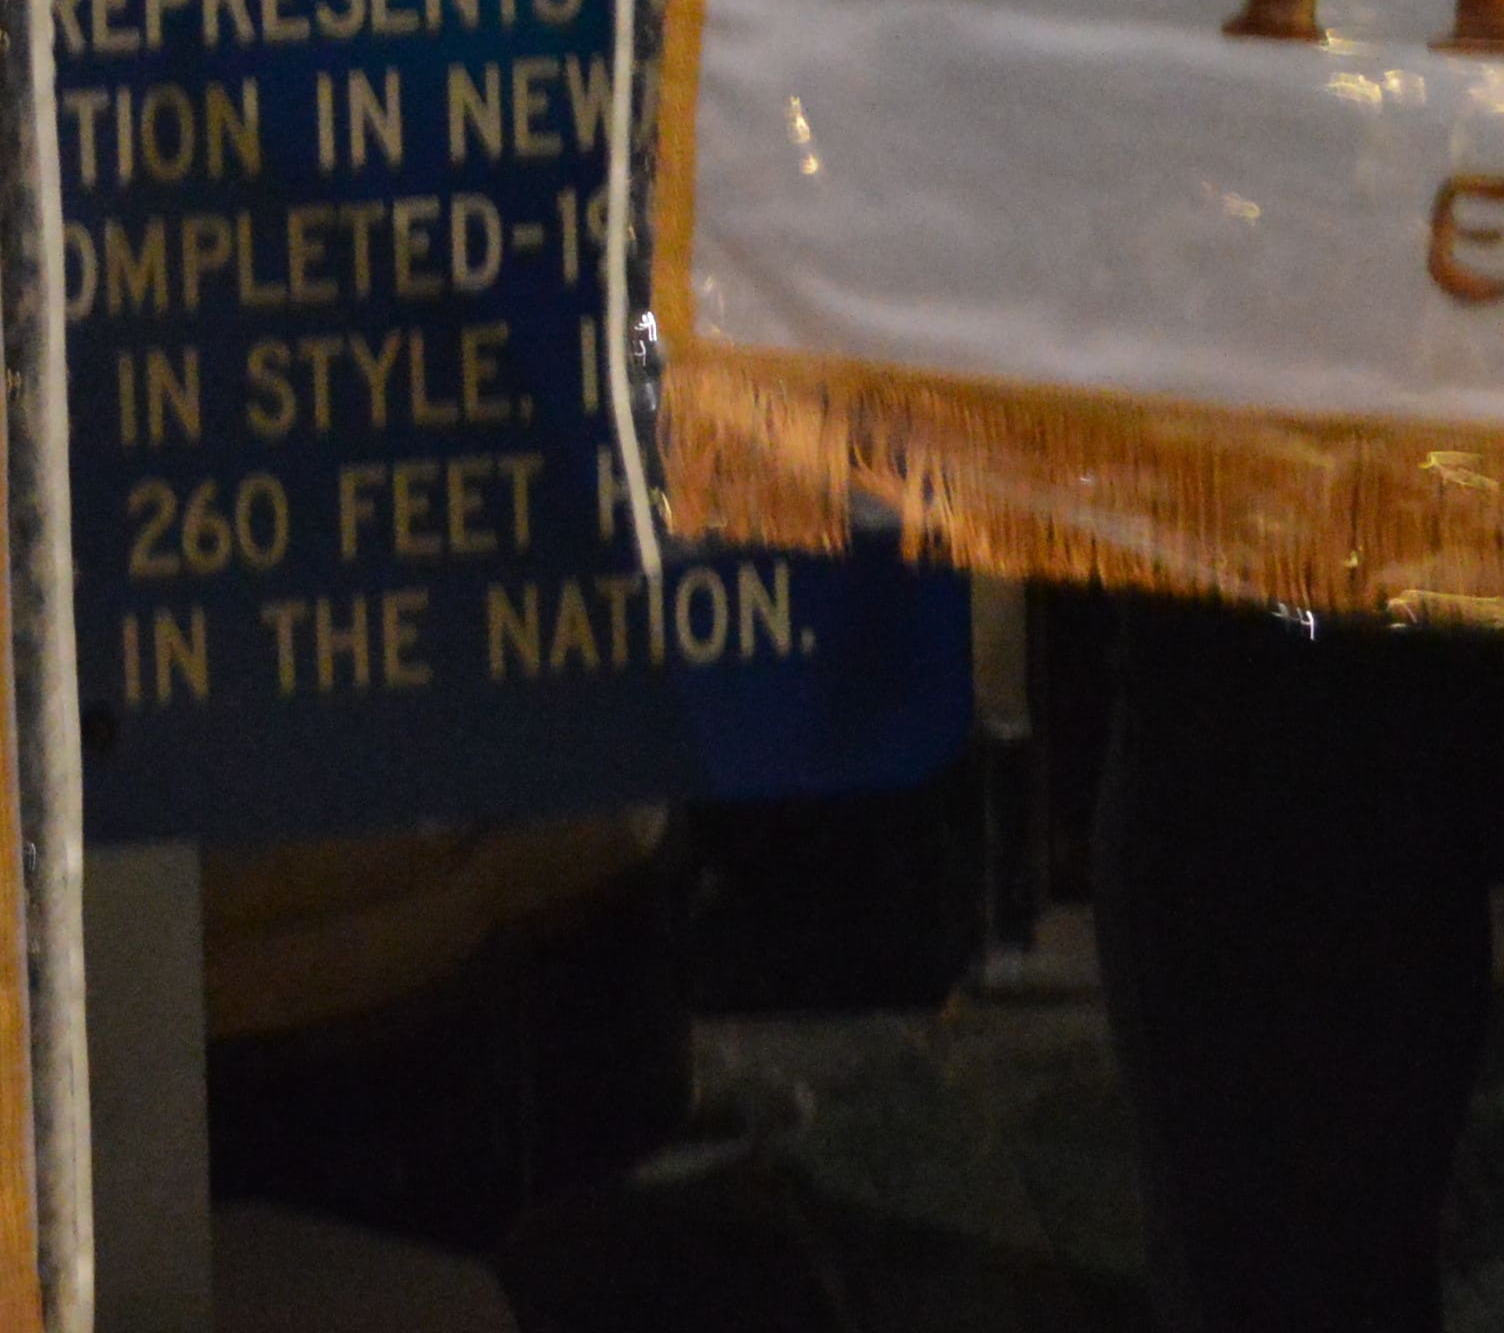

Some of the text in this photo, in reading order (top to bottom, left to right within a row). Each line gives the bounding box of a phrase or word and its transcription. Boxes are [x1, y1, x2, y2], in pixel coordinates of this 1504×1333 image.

[315, 64, 403, 173] IN
[114, 343, 201, 448] IN
[126, 471, 291, 579] 260
[339, 450, 544, 562] FEET
[121, 560, 818, 707] IN THE NATION.
